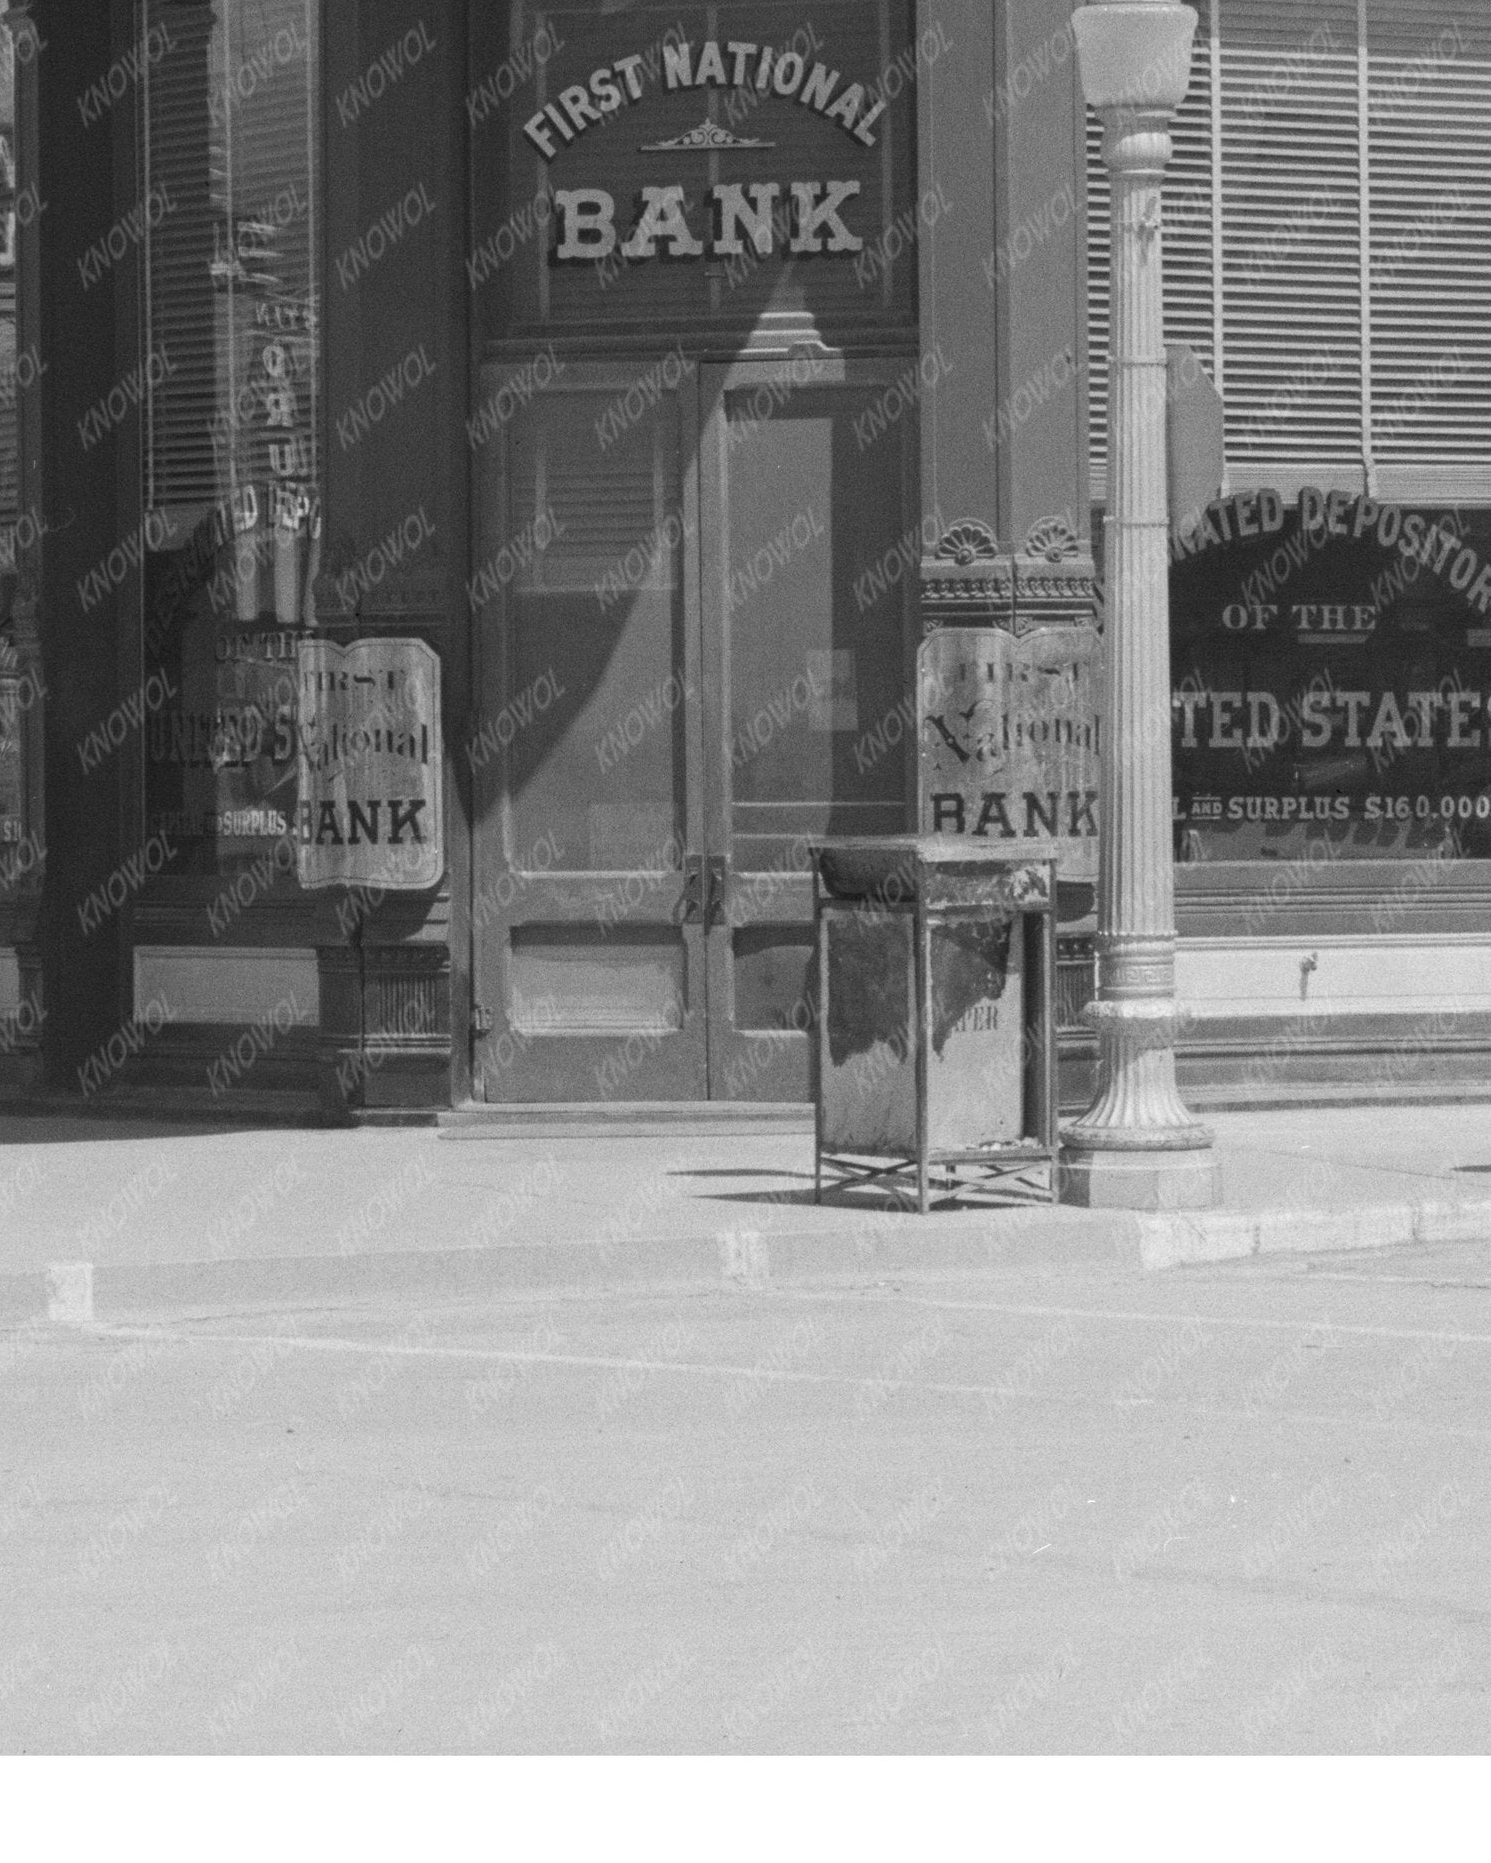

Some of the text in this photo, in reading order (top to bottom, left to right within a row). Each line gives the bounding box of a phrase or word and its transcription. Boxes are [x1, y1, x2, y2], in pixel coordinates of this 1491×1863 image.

[523, 41, 886, 158] FIRST NATIONAL
[555, 180, 863, 259] BANK
[1222, 604, 1376, 629] OF THE
[301, 799, 426, 846] BANK
[930, 790, 1099, 838] BANK
[1191, 801, 1222, 814] AND
[1227, 795, 1350, 820] SURPLUS
